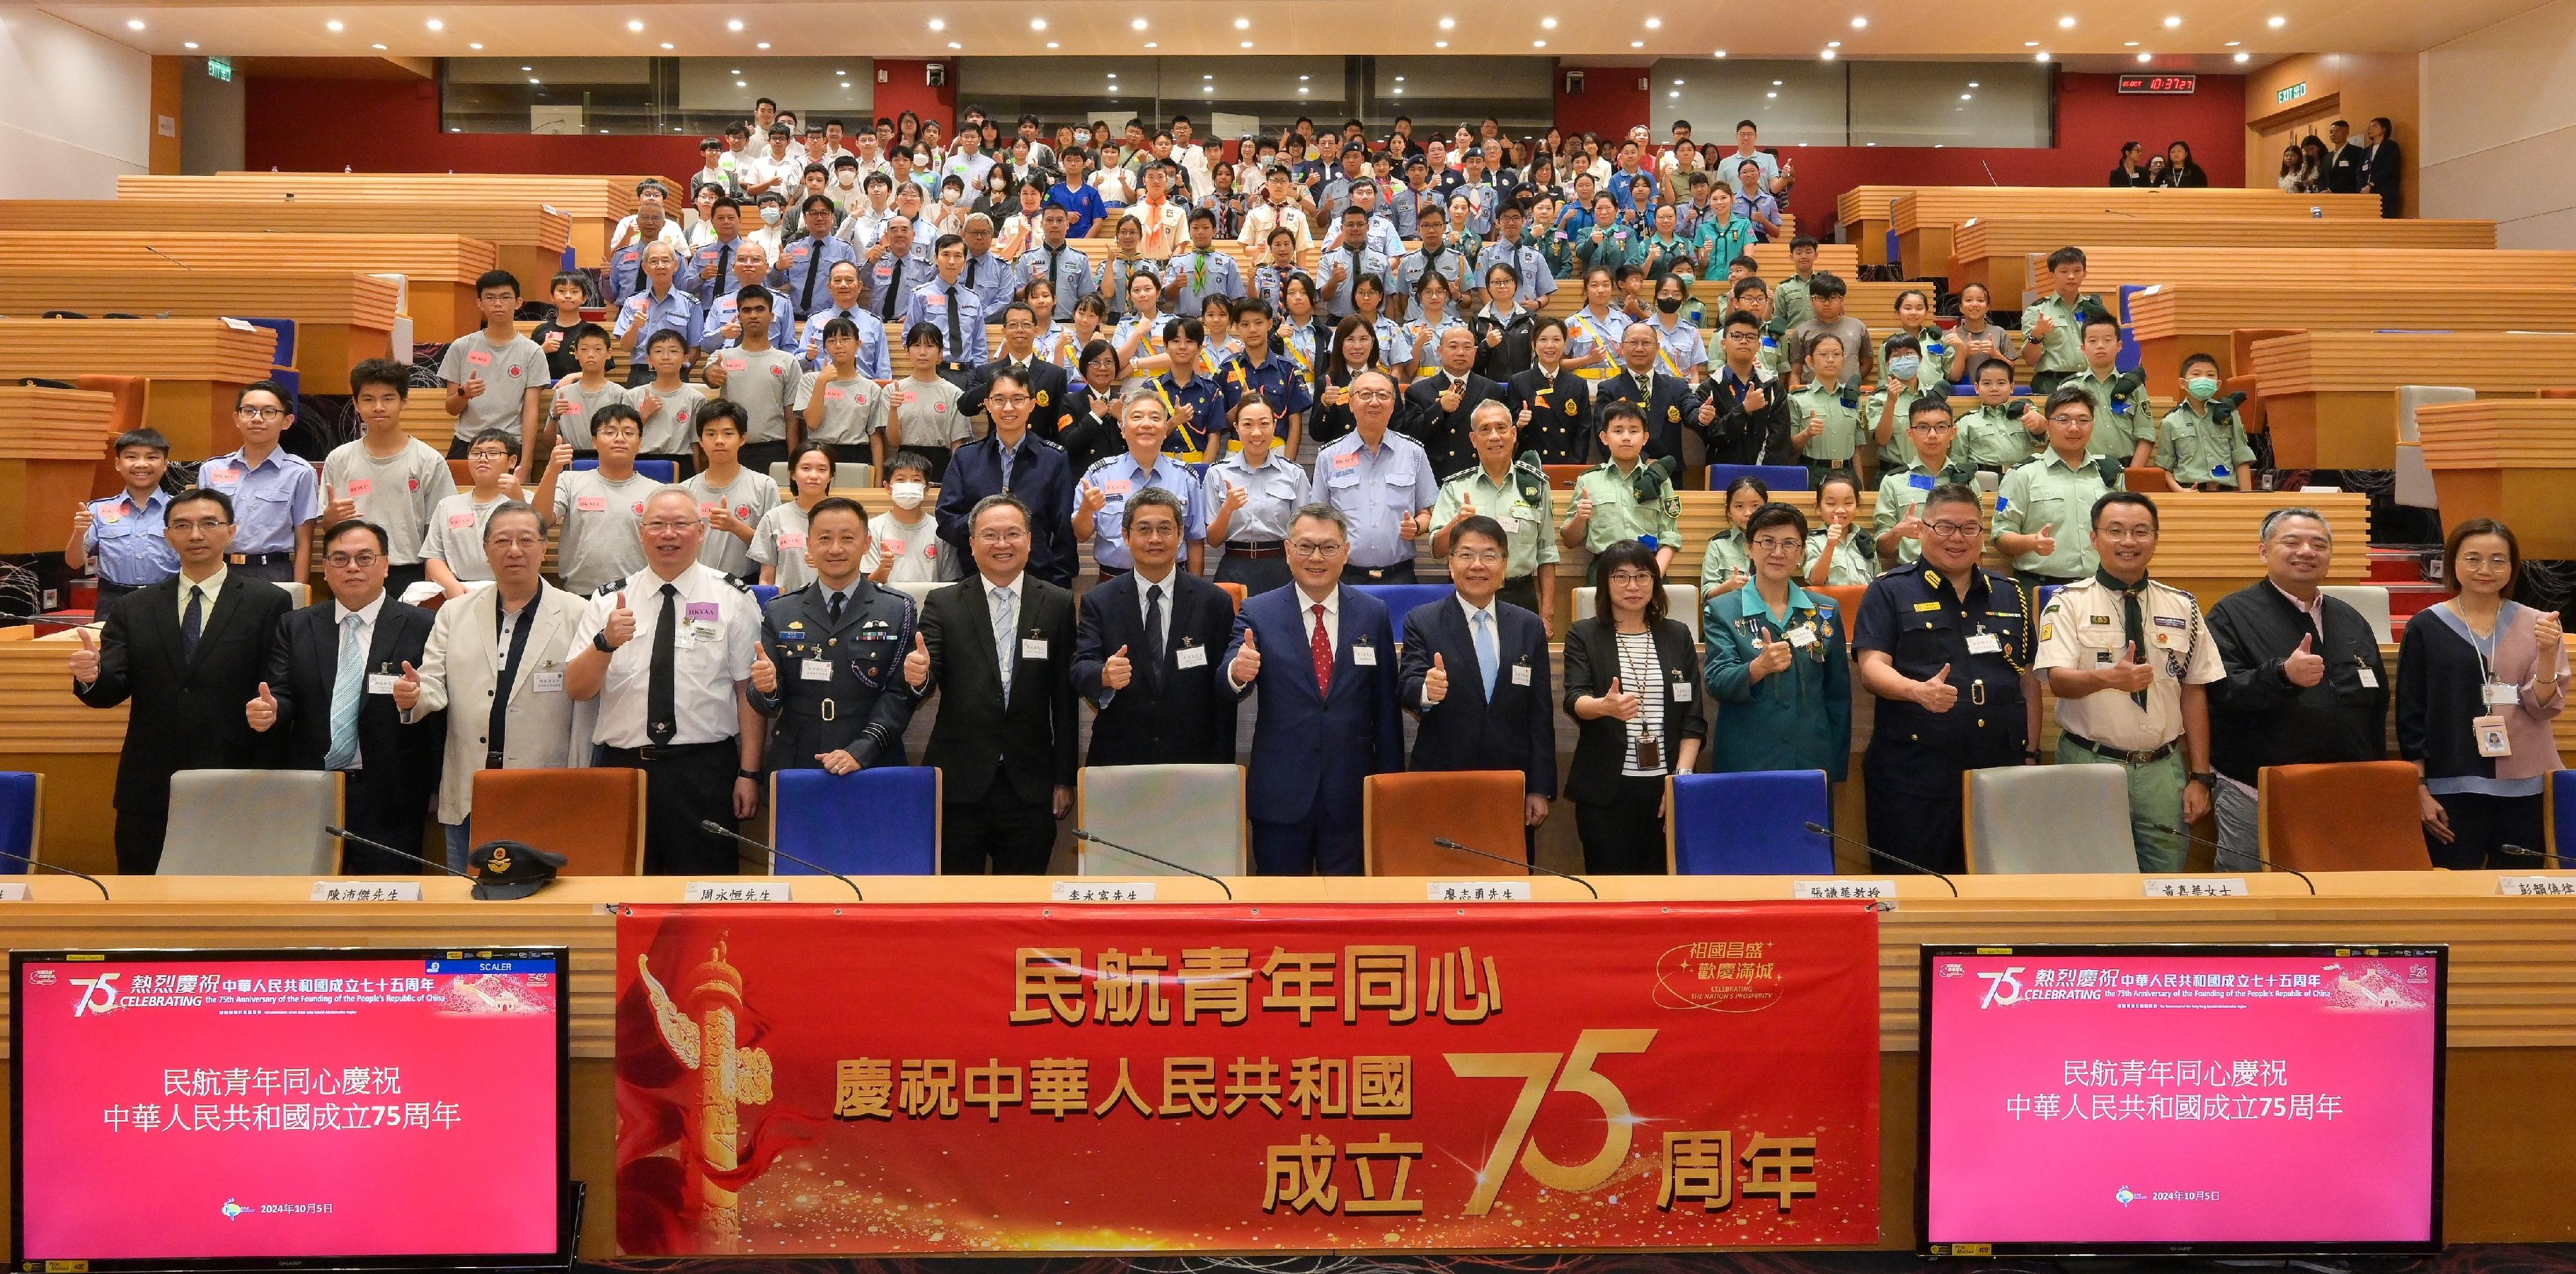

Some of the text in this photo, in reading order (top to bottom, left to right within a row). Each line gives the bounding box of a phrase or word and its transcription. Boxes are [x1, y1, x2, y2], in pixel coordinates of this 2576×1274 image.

[2150, 78, 2179, 89] 10:37
[2179, 81, 2192, 90] 27
[2278, 83, 2306, 103] EXIT 出口
[327, 888, 399, 900] 陳沛傑先生
[1689, 942, 1765, 959] 祖國昌盛
[1698, 962, 1774, 982] 歡慶滿城
[2034, 968, 2321, 987] 熱烈慶祝 中華人民共和國成立七十五周年
[130, 974, 435, 994] 熱烈慶祝 中華人民共和國成立七十五周年
[1009, 945, 1501, 1025] 民航青年同心
[1976, 967, 2026, 1009] 75
[68, 973, 122, 1018] 75
[120, 996, 202, 1007] CELEBRATING
[236, 995, 277, 1004] Anniversary
[301, 994, 333, 1004] Founding
[357, 994, 385, 1003] People's
[386, 994, 416, 1003] Republic
[426, 994, 446, 1002] China
[2024, 989, 2102, 1000] CELEBRATING
[2133, 990, 2172, 998] Anniversary
[2194, 990, 2224, 998] Founding
[2247, 989, 2273, 998] People's
[2275, 989, 2303, 998] Republic
[163, 1066, 401, 1097] 民航青年同心慶祝
[2063, 1058, 2287, 1087] 民航青年同心慶祝
[834, 1054, 1413, 1119] 慶祝中華人民共和國
[103, 1101, 462, 1133] 中華人民共和國成立75周年
[2006, 1093, 2344, 1121] 中華人民共和國成立75周年
[1262, 1028, 1817, 1215] 成立 75 周年
[2152, 1190, 2221, 1202] 2024年10月5日
[260, 1203, 333, 1214] 2024年10月5日
